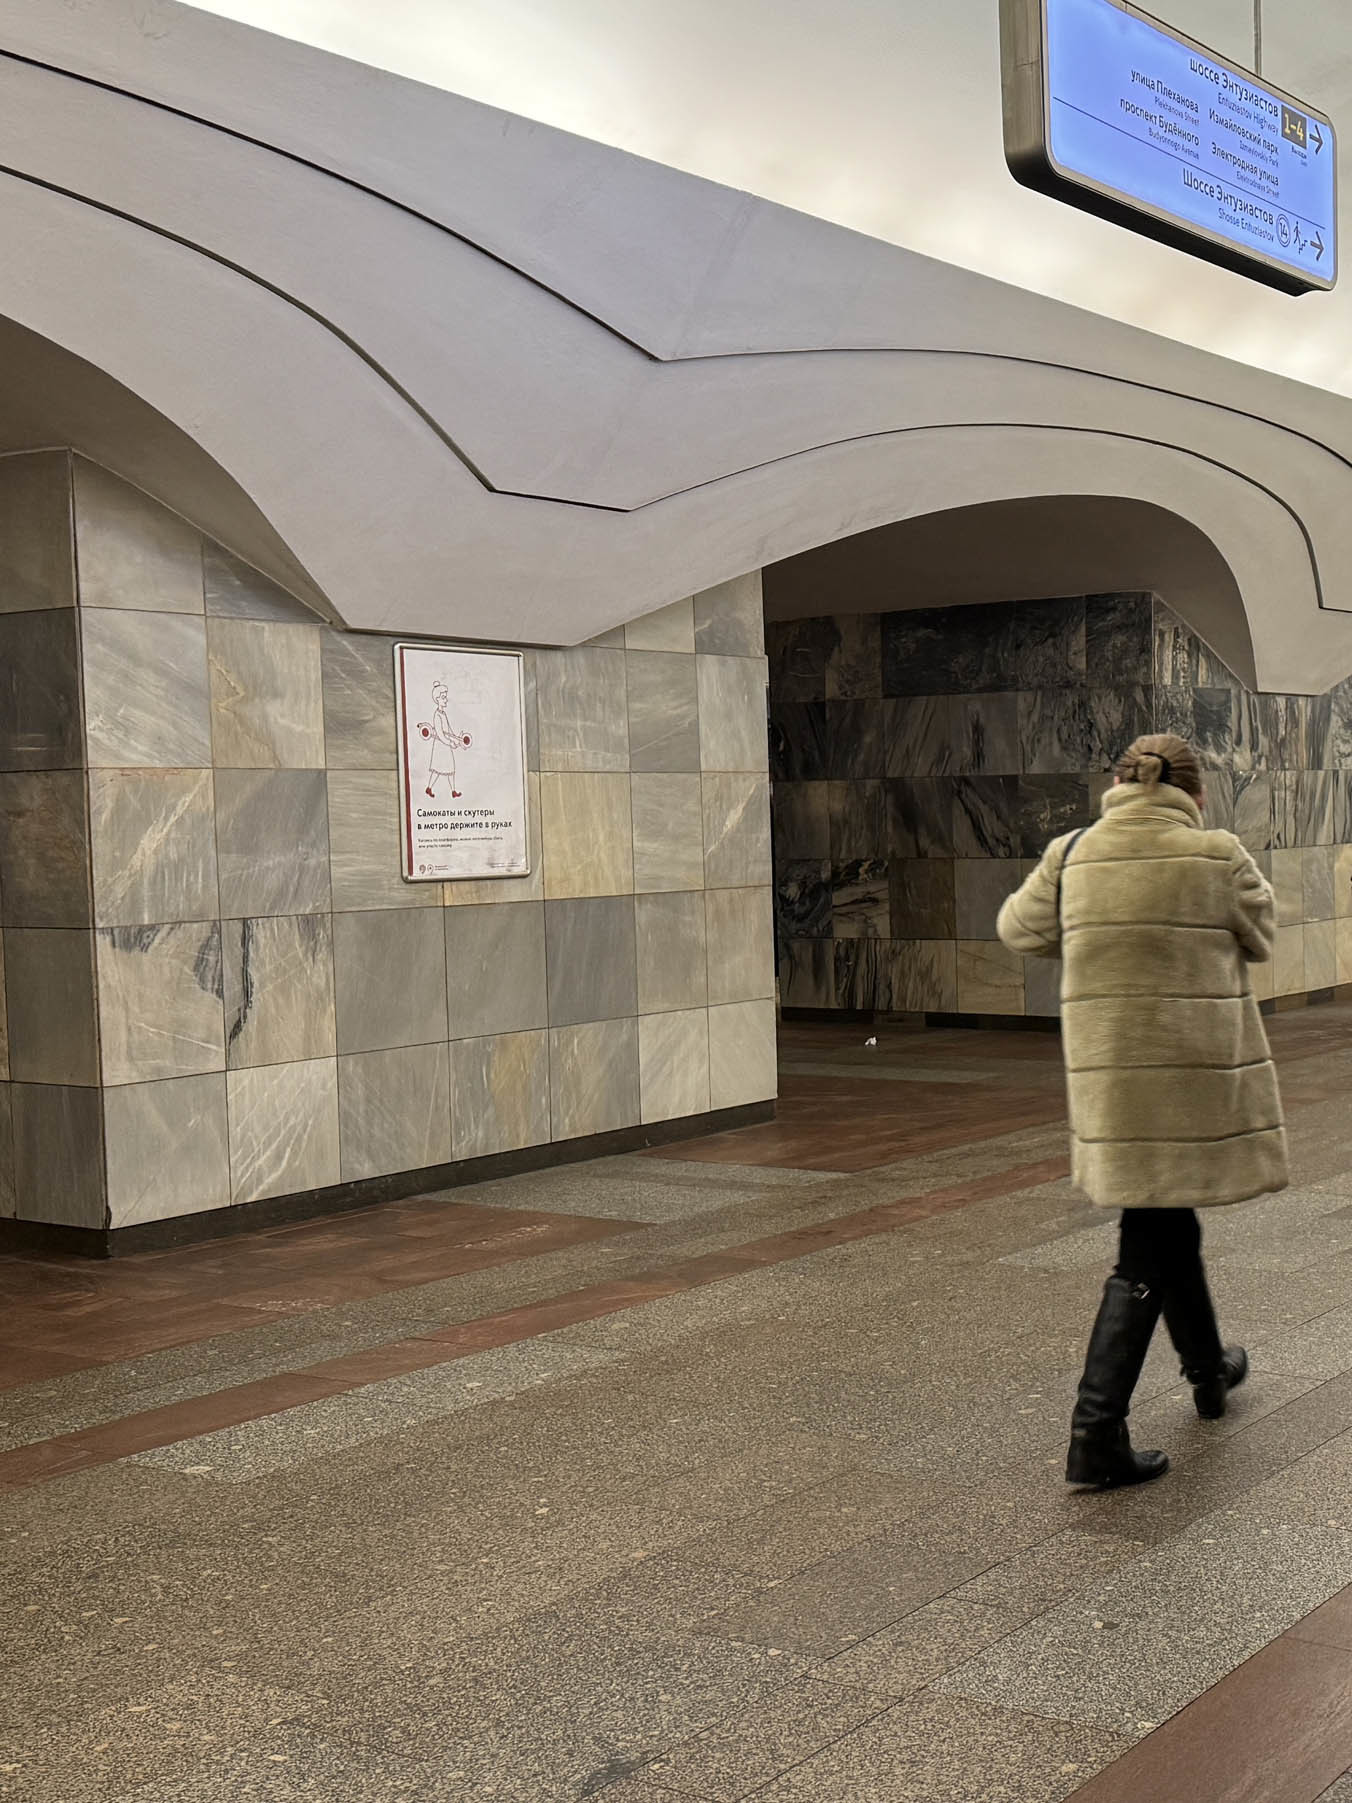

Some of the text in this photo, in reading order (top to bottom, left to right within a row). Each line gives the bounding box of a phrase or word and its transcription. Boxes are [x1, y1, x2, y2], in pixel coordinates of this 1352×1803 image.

[1131, 69, 1199, 113] улица Плеханова
[1190, 58, 1278, 117] шоссе Энтузиастов
[1120, 98, 1200, 146] проспект Будённого
[1209, 108, 1279, 155] Измайловский парк
[1284, 113, 1304, 141] 1-4
[1211, 142, 1279, 187] Электродная улица
[1183, 168, 1274, 225] Шоссе Энтузиастов
[417, 808, 495, 818] Самокаты и скутеры
[423, 822, 448, 831] метро
[450, 821, 483, 831] держите
[491, 820, 513, 830] руках
